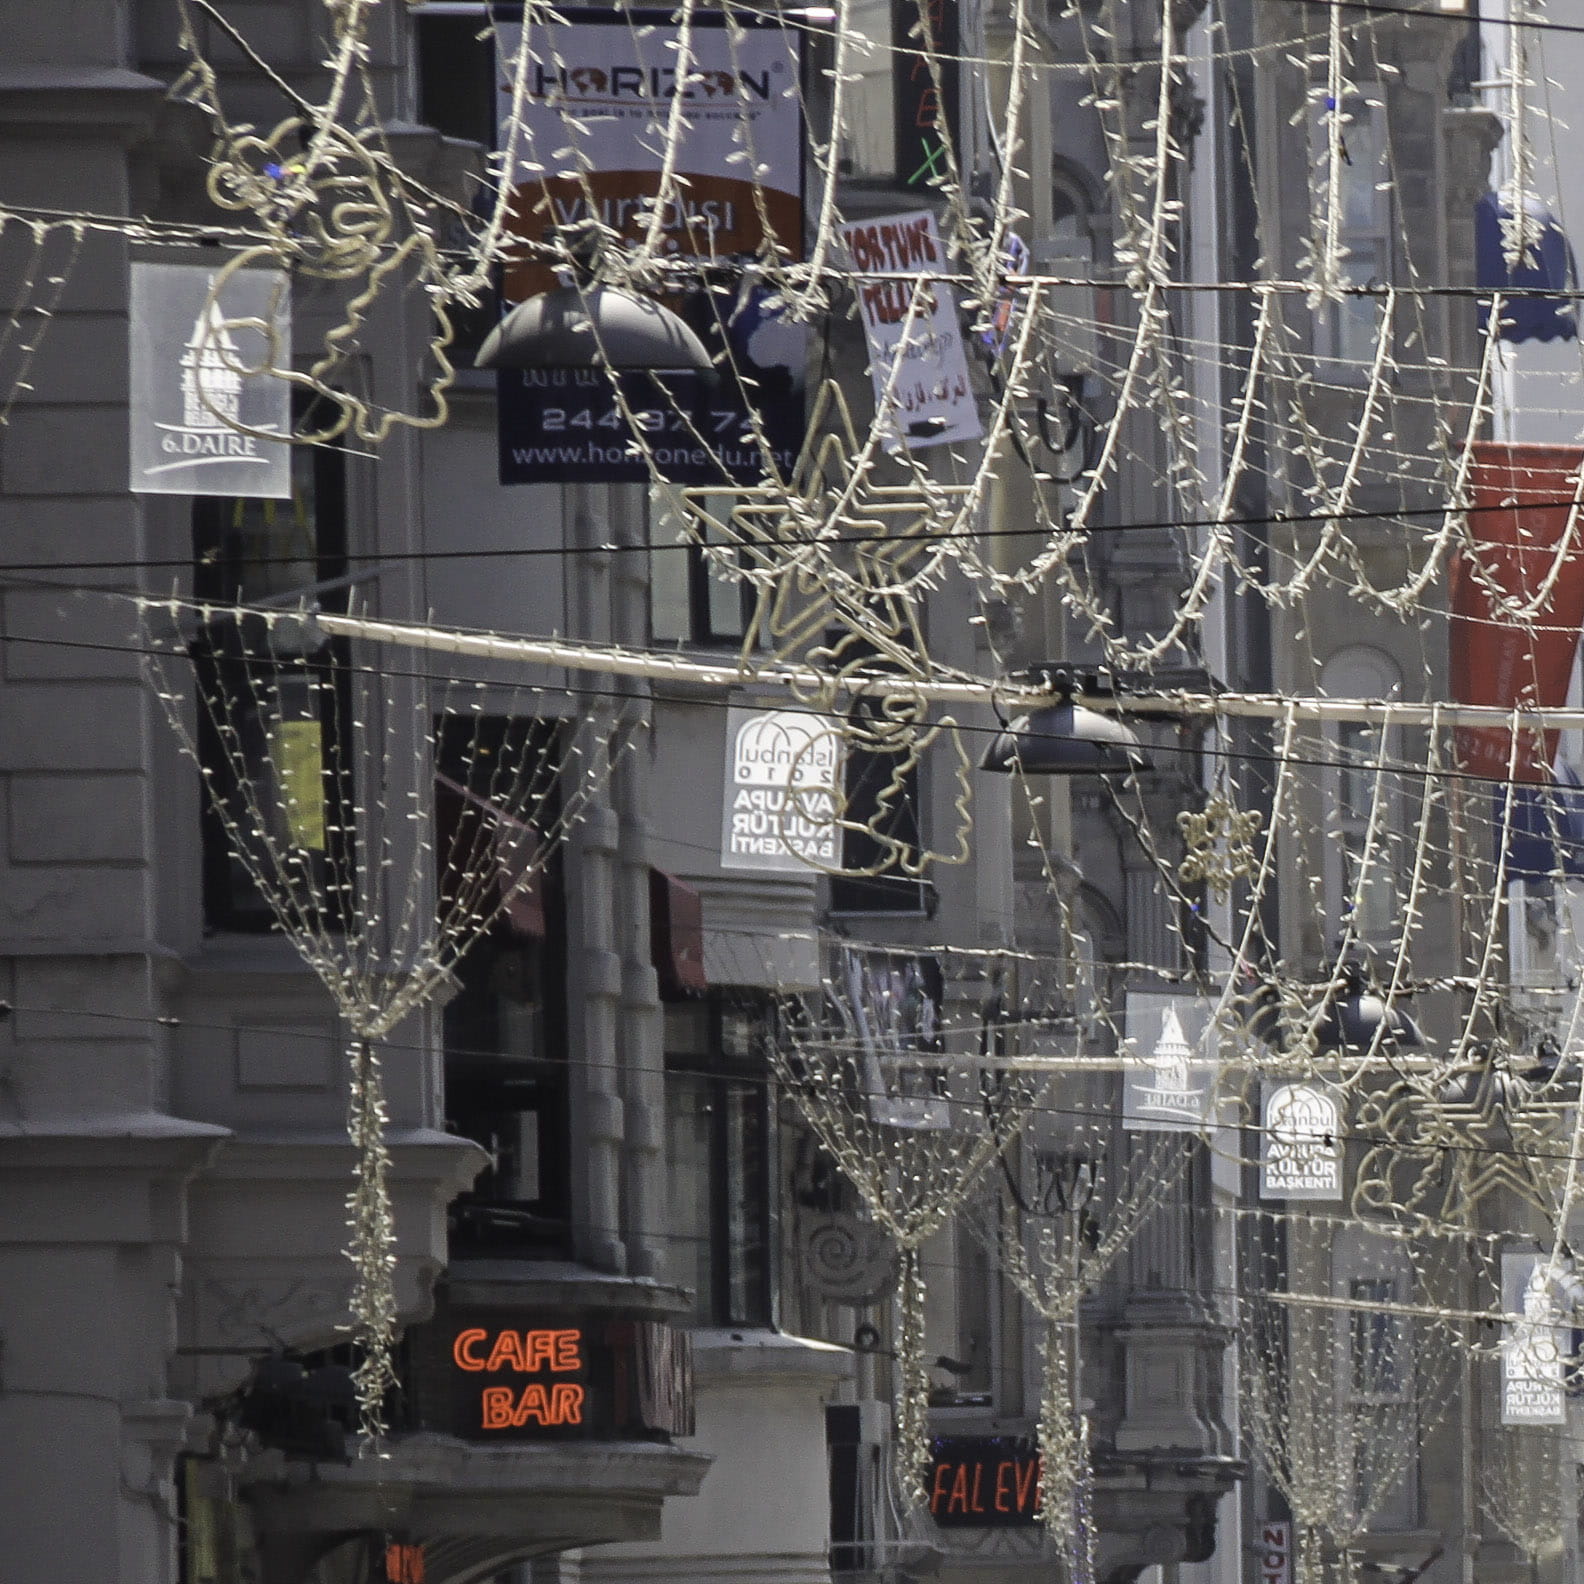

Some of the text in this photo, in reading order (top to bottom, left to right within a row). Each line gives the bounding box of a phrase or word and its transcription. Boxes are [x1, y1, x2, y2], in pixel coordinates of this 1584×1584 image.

[541, 408, 620, 433] 244
[452, 1327, 582, 1373] CAFE
[481, 1383, 585, 1430] BAR
[929, 1462, 985, 1513] FAL
